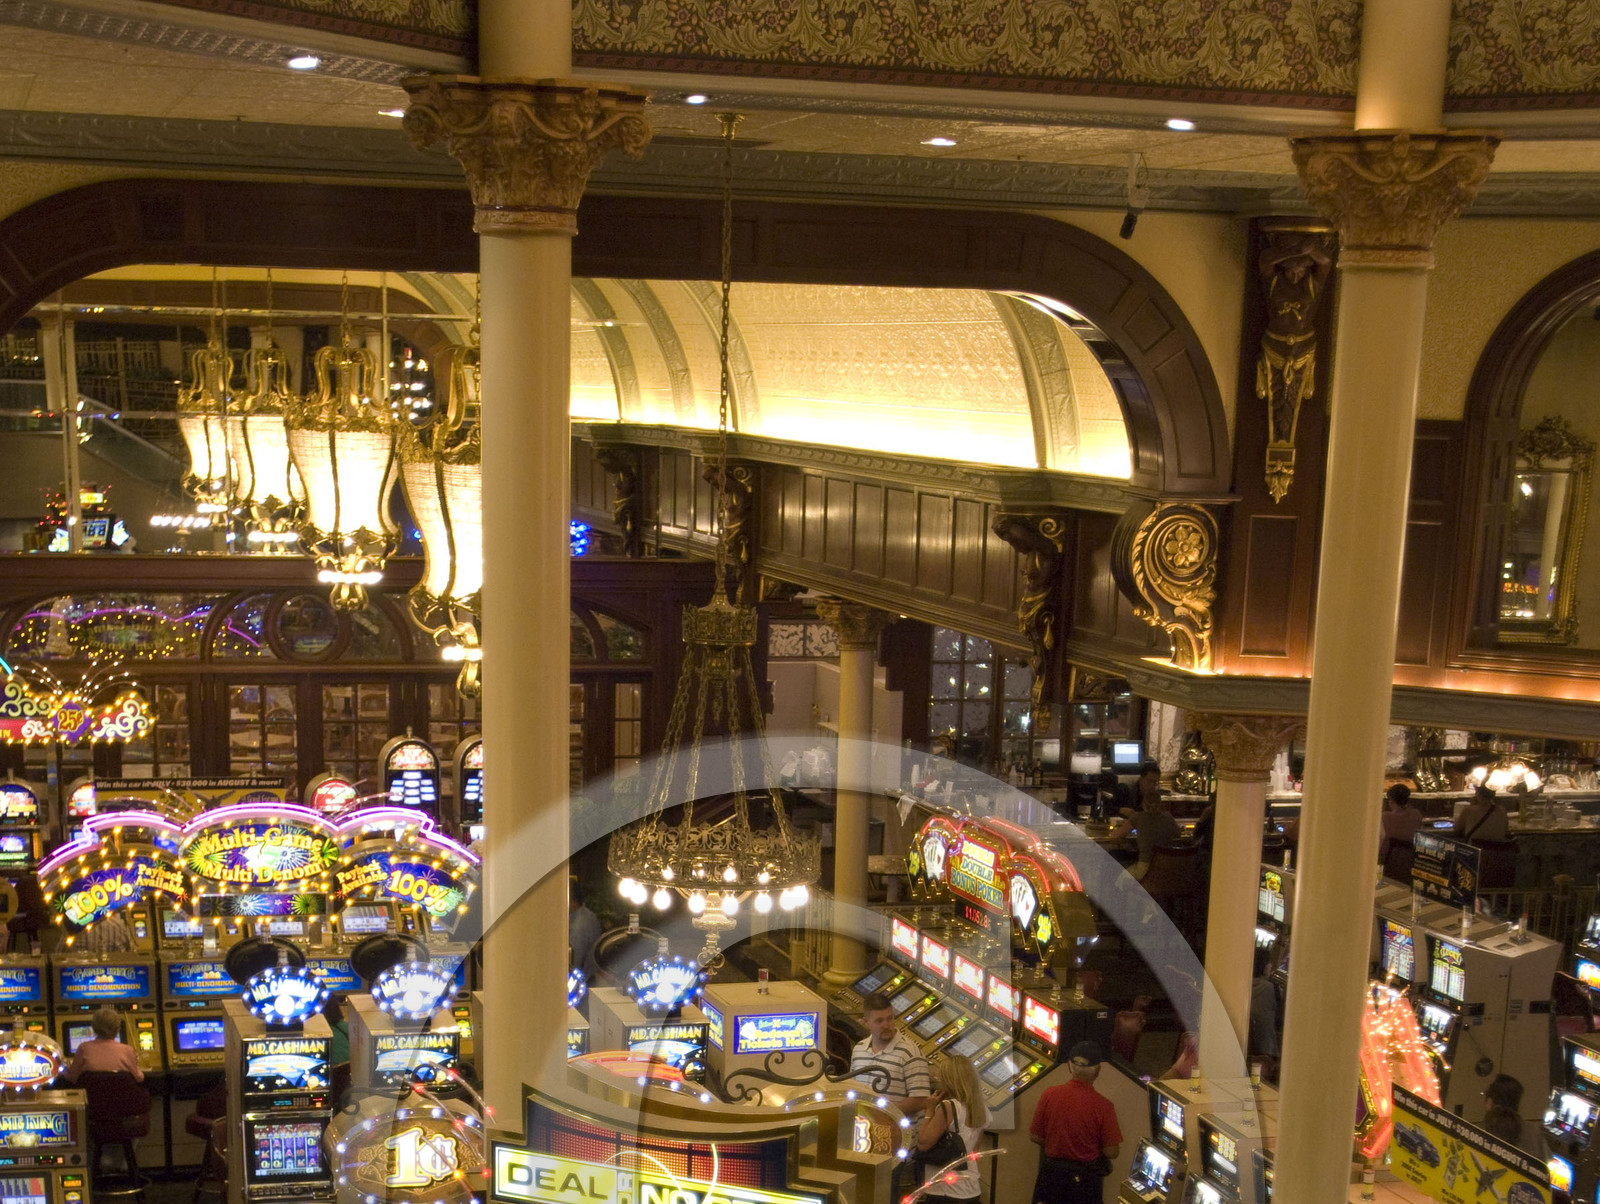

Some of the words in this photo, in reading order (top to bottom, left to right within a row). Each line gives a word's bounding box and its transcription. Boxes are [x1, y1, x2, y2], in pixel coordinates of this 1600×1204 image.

[58, 707, 84, 732] 25¢
[96, 779, 112, 789] Win
[114, 779, 128, 788] this
[129, 780, 142, 788] car
[208, 779, 217, 787] in
[217, 778, 250, 787] AUGUST
[259, 778, 282, 786] more!
[199, 827, 322, 852] Multi-Game
[137, 864, 184, 882] Payback
[202, 863, 252, 882] Multi
[256, 861, 322, 882] Denom
[336, 859, 381, 884] Payback
[950, 867, 976, 896] BONUS
[960, 856, 994, 884] DOUBLE
[135, 875, 185, 895] Available
[341, 871, 388, 895] Available
[389, 870, 450, 913] 100%
[976, 879, 1004, 910] POKER
[66, 875, 133, 920] 100%
[398, 1035, 453, 1049] CASHMAN
[649, 1025, 703, 1040] CASHMAN
[740, 1040, 783, 1050] Tickets
[785, 1038, 814, 1048] Here
[268, 1040, 325, 1055] CASHMAN
[27, 1114, 67, 1135] KING
[1418, 1104, 1428, 1116] car
[1429, 1109, 1436, 1119] in
[1436, 1111, 1453, 1129] JULY
[1484, 1139, 1491, 1150] in
[1491, 1143, 1521, 1166] AUGUST
[1521, 1159, 1528, 1171] &
[384, 1127, 458, 1187] 1¢
[507, 1162, 608, 1200] DEAL
